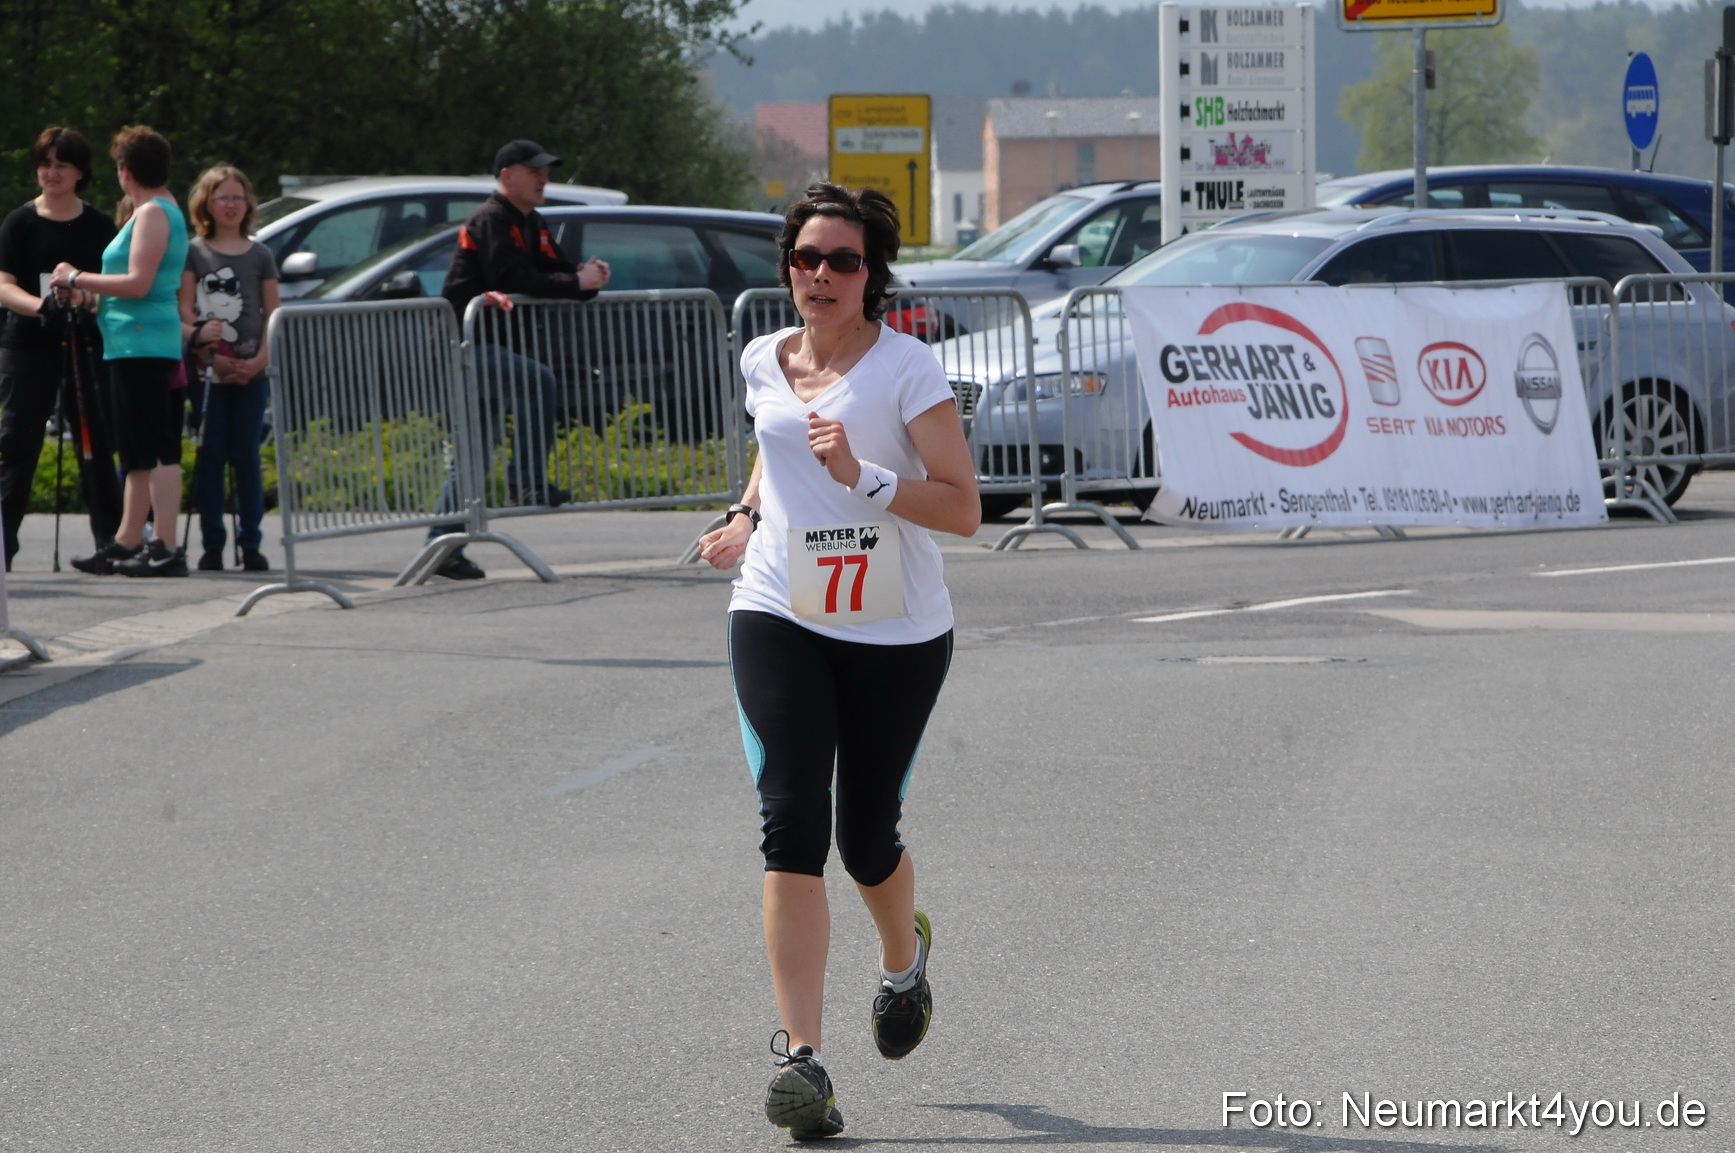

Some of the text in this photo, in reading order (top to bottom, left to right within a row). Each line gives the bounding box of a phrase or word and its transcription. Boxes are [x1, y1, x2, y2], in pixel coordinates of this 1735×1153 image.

[1226, 9, 1284, 27] HOLZAMMER
[1226, 51, 1284, 69] HOLZAMMER
[1195, 96, 1285, 128] SHB Holzfachmarkt
[1195, 180, 1244, 210] THULE
[1159, 343, 1316, 384] GERHART &
[1426, 357, 1475, 391] KIA
[1167, 384, 1247, 408] Autohaus
[1247, 382, 1336, 420] JÄNIG
[1366, 416, 1416, 436] SEAT
[1424, 414, 1507, 439] KIA MOTORS
[1179, 490, 1268, 521] Neumarkt
[1278, 486, 1352, 519] Sengenthal
[1358, 486, 1383, 512] Tel.
[805, 527, 856, 544] MEYER
[805, 540, 857, 552] WERBUNG
[816, 554, 869, 614] 77
